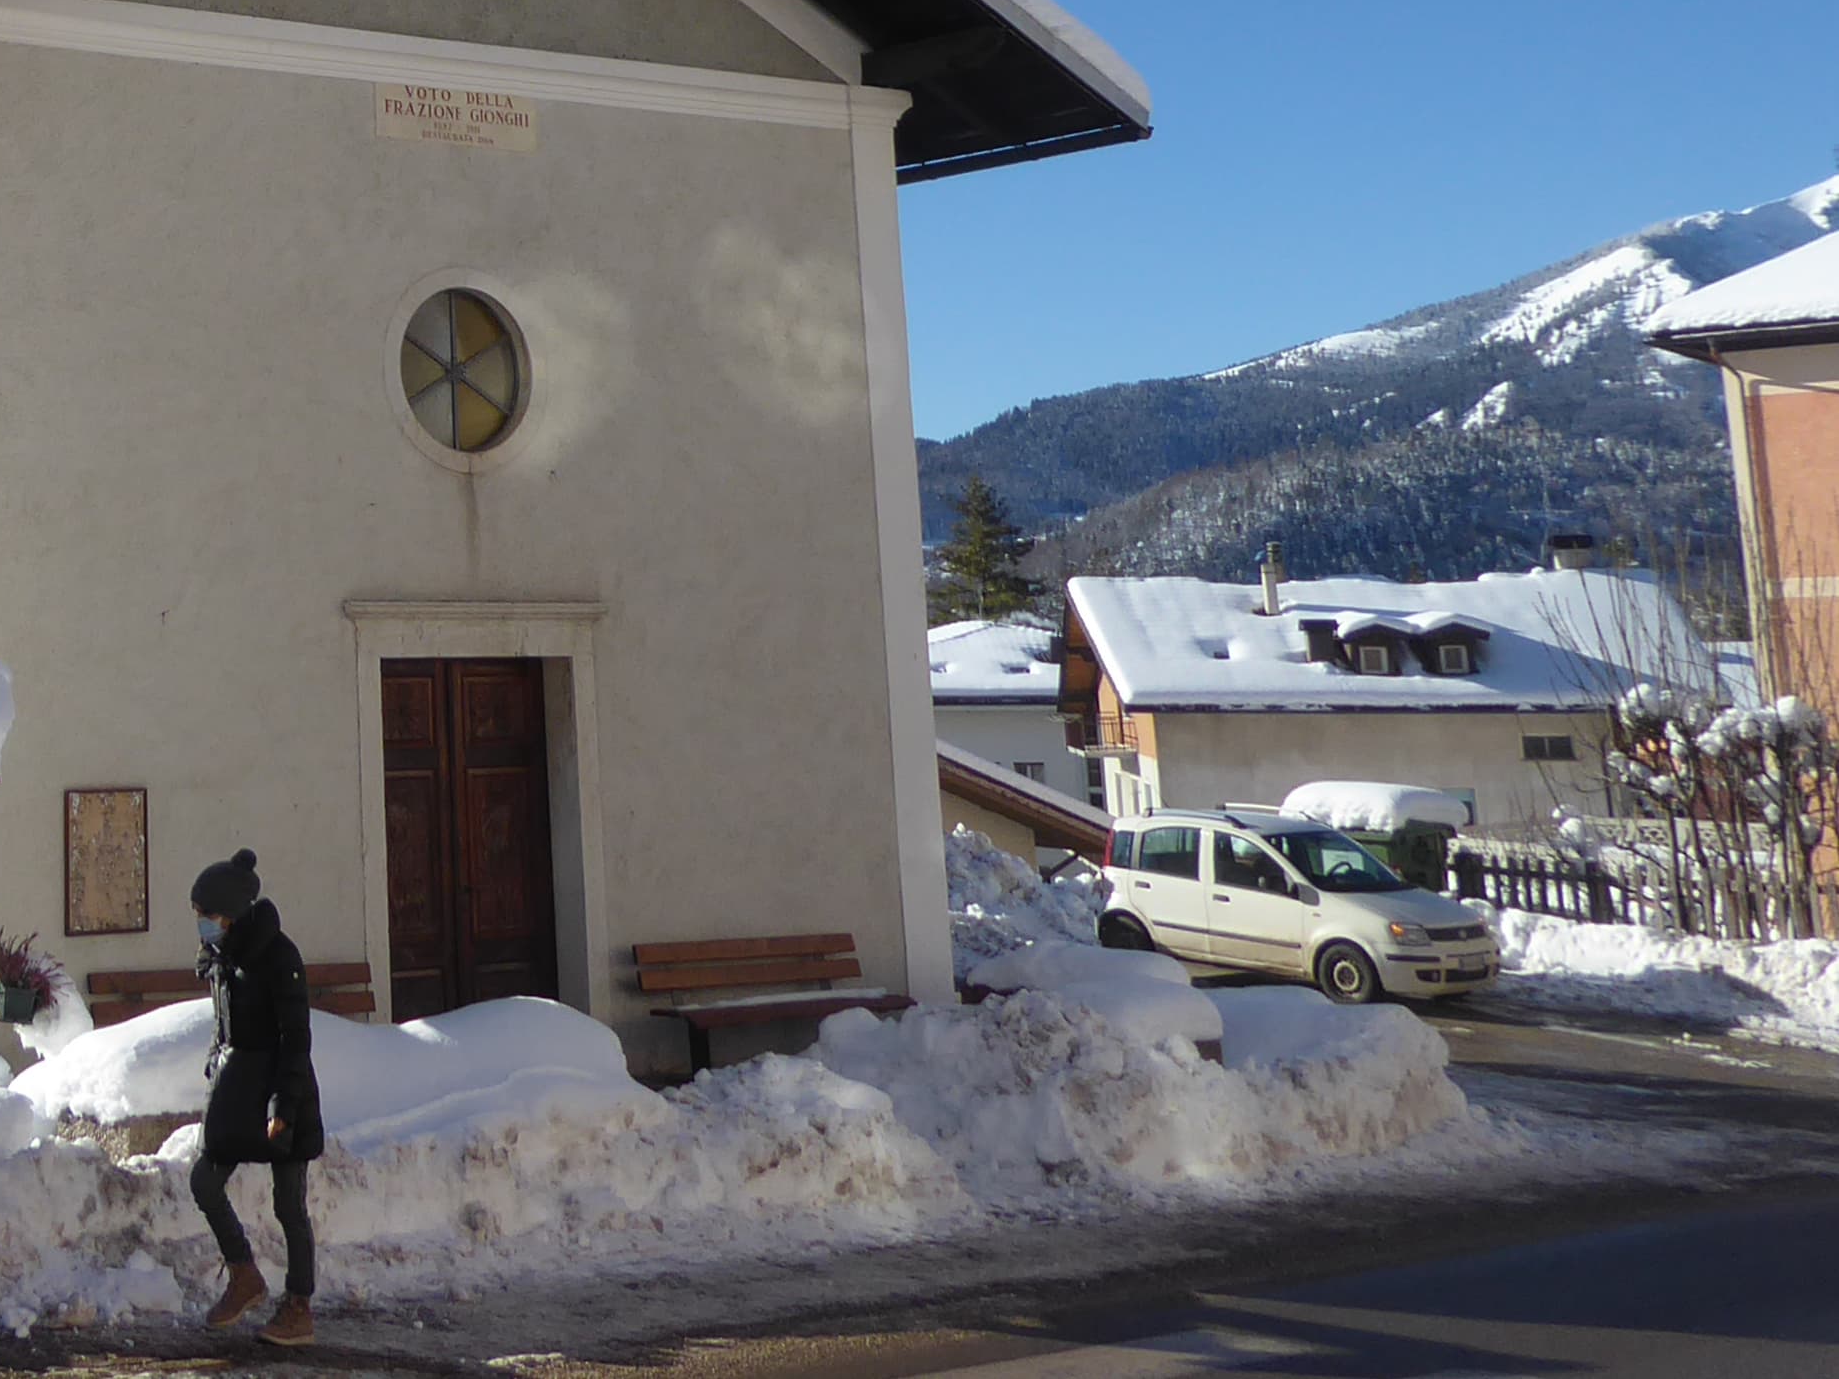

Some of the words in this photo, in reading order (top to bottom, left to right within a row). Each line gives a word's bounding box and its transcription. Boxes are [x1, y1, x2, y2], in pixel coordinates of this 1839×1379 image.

[404, 84, 452, 102] VOTO
[465, 91, 515, 110] DELLA
[384, 98, 462, 121] FRAZIONE
[469, 108, 530, 128] GIONGHI
